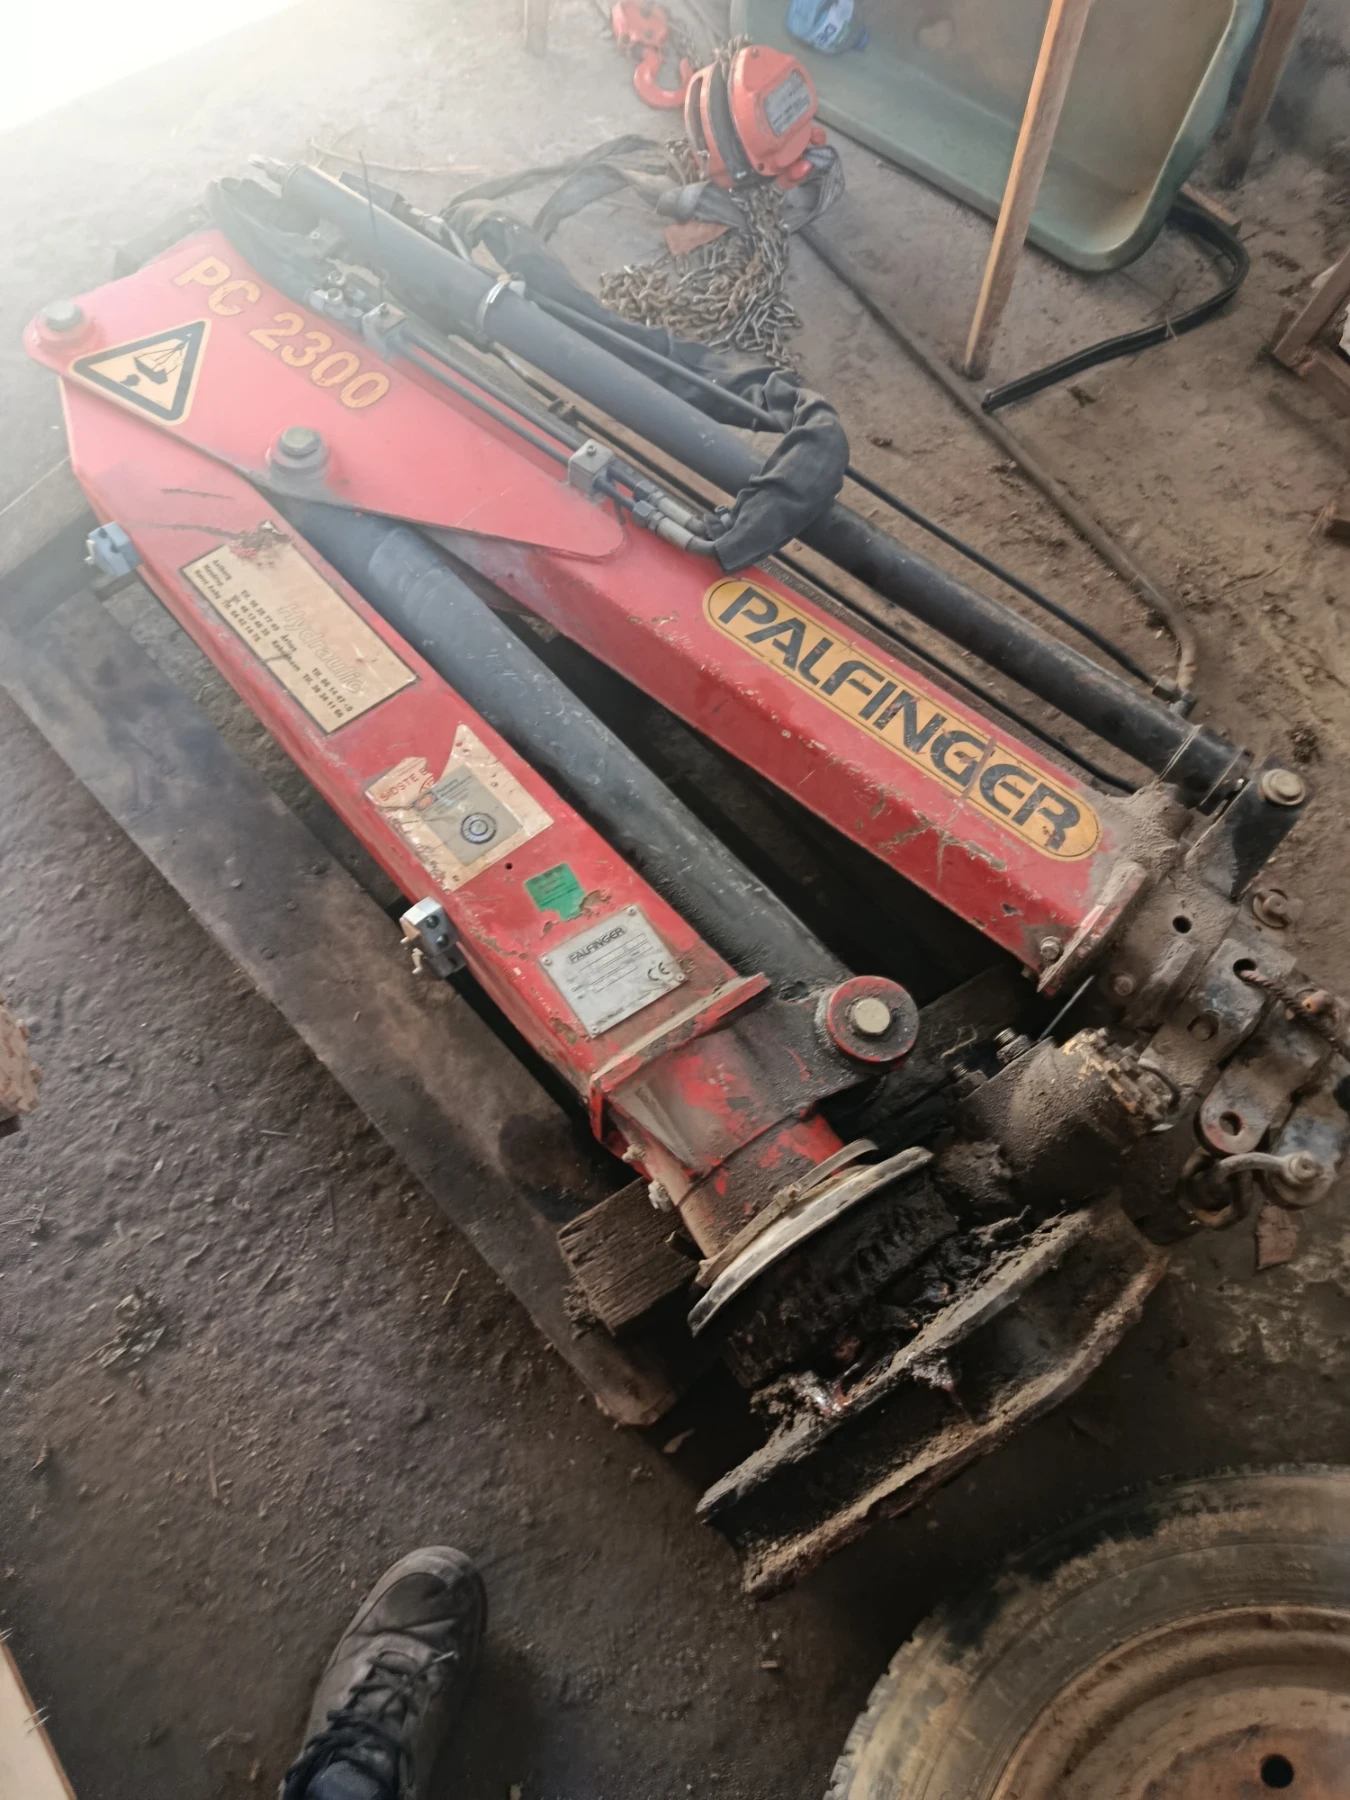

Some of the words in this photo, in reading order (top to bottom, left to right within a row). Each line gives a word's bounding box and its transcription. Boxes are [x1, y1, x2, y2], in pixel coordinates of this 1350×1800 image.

[172, 256, 261, 316] PC
[249, 312, 390, 408] 2300
[277, 603, 365, 694] Hydraulic
[718, 587, 1081, 851] PALFINGER
[379, 773, 419, 801] SIDSTE
